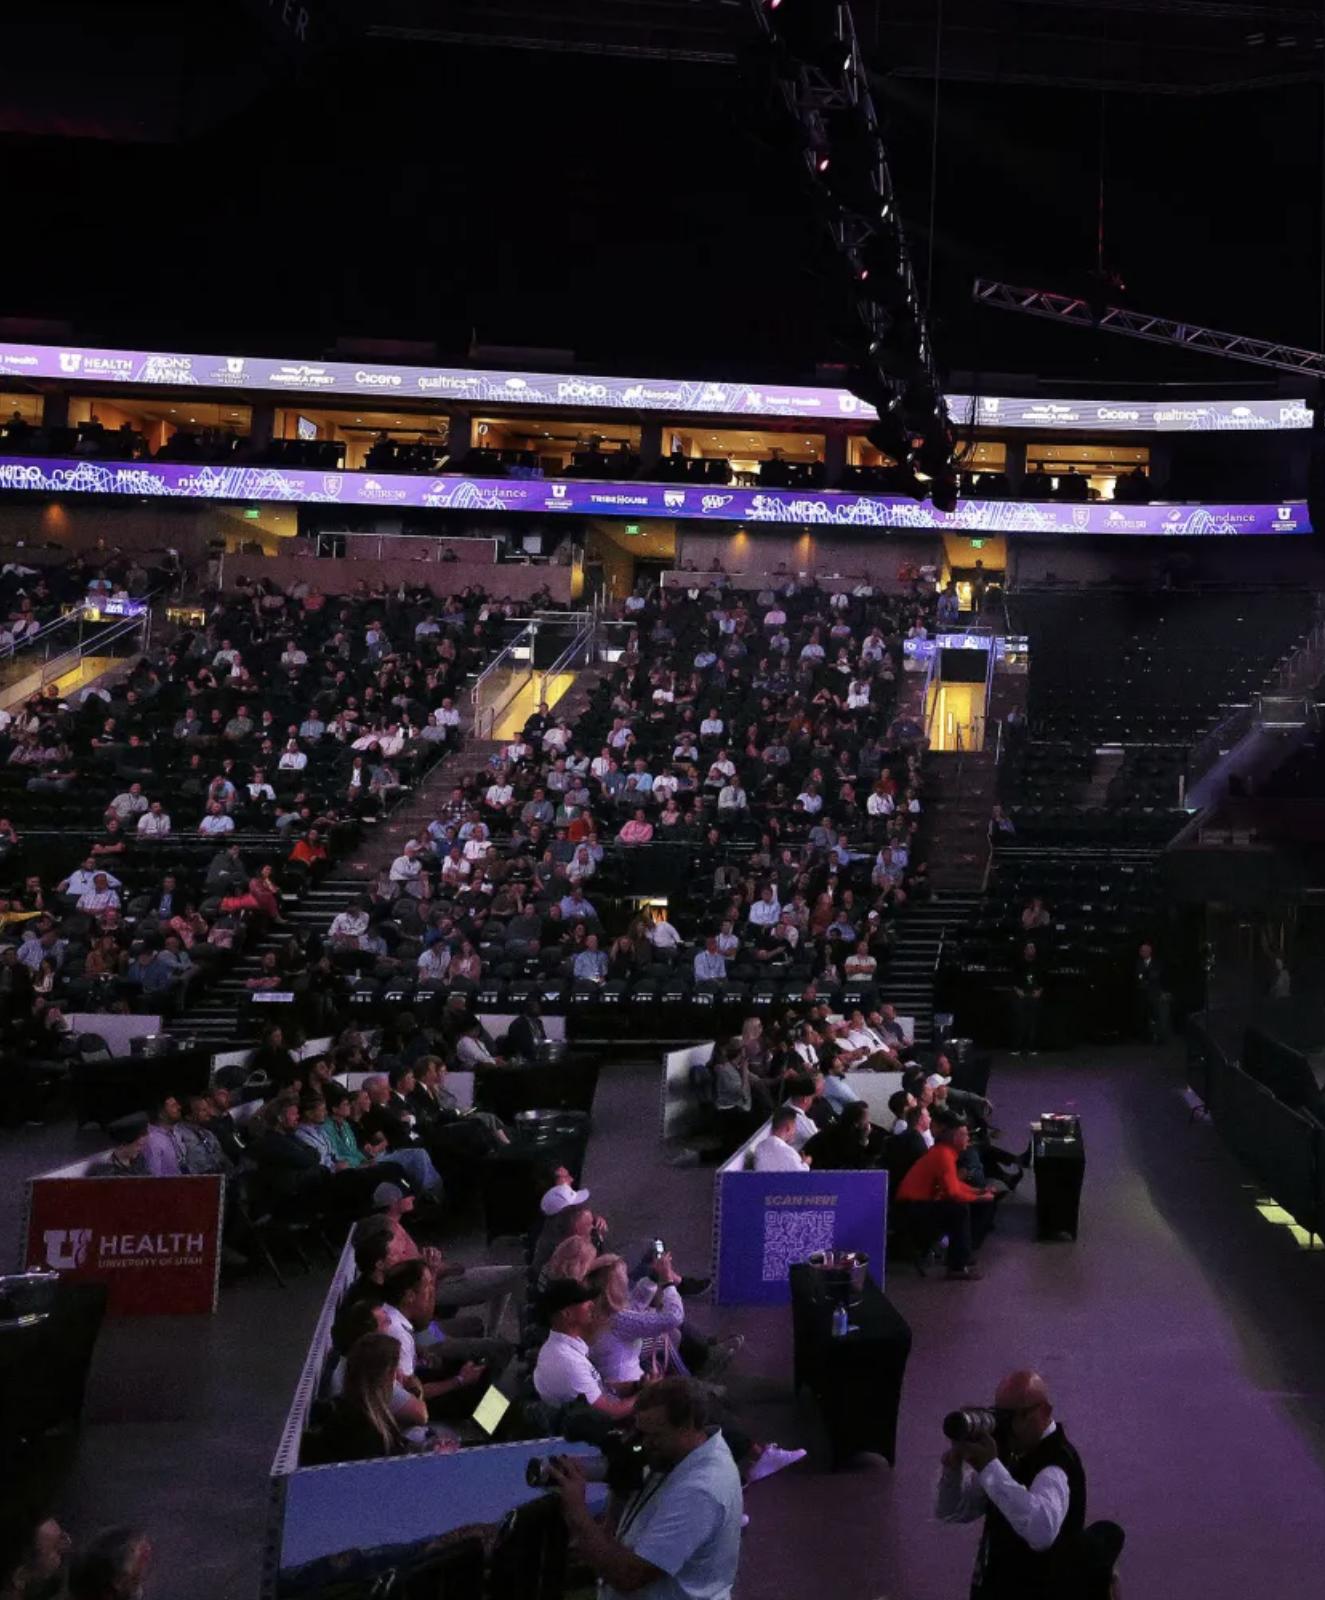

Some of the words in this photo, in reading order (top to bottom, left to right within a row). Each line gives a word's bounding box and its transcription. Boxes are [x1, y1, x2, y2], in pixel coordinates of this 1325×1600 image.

[84, 357, 133, 370] HEALTH
[418, 375, 466, 390] qualtrics
[557, 383, 606, 398] DOMO
[1153, 409, 1198, 424] qualtrics
[764, 1194, 802, 1207] SCAN
[803, 1194, 838, 1207] HERE
[100, 1232, 204, 1256] HEALTH
[99, 1258, 157, 1269] UNIVERSITY
[159, 1257, 174, 1267] OF
[175, 1256, 203, 1267] UTAH
